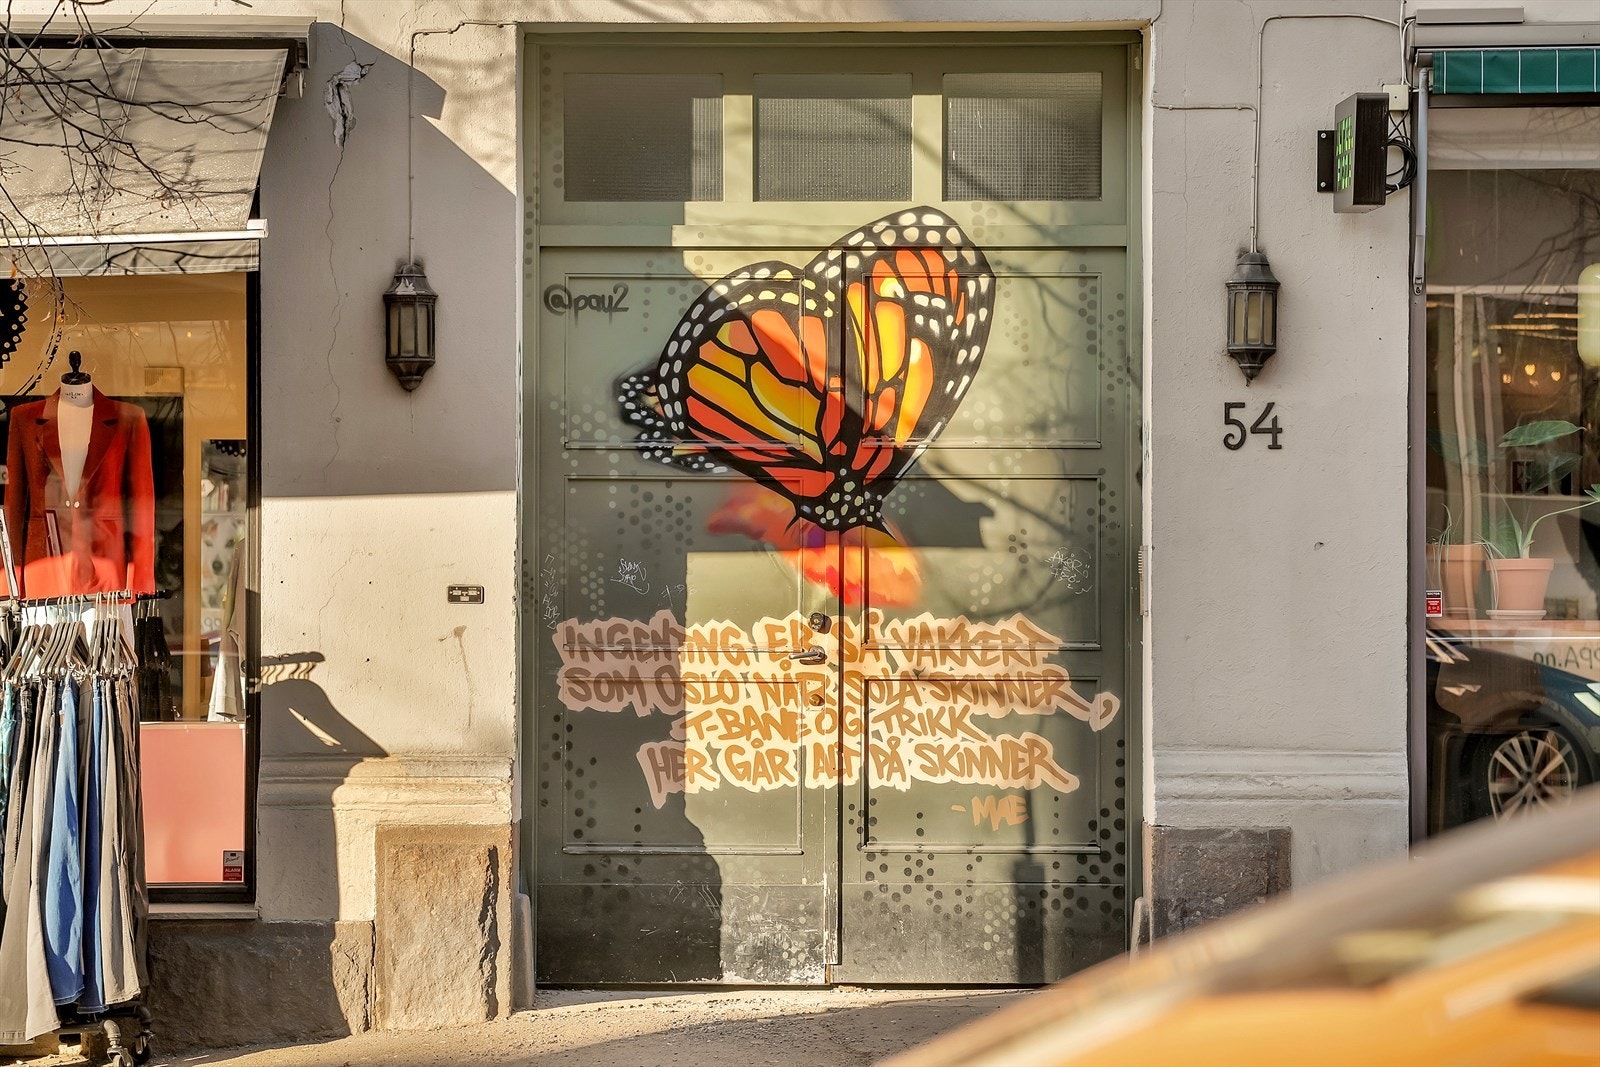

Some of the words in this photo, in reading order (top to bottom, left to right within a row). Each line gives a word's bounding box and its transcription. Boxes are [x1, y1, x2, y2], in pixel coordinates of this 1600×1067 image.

[1223, 402, 1283, 451] 54
[564, 617, 751, 666] INGENTING
[831, 611, 881, 664] SÅ
[890, 619, 1063, 668] VAKKERT
[563, 665, 648, 707] SOM
[653, 664, 740, 708] OSLO
[752, 659, 837, 713] NÅR
[844, 667, 921, 708] SOLA
[680, 705, 812, 743] T-BANE
[815, 707, 863, 736] OG
[872, 705, 988, 743] TRIKK
[647, 746, 718, 794] HER
[725, 738, 796, 785] GÅR
[812, 742, 861, 780] ALT
[869, 736, 907, 782] PÅ
[914, 736, 1070, 785] SKINNER
